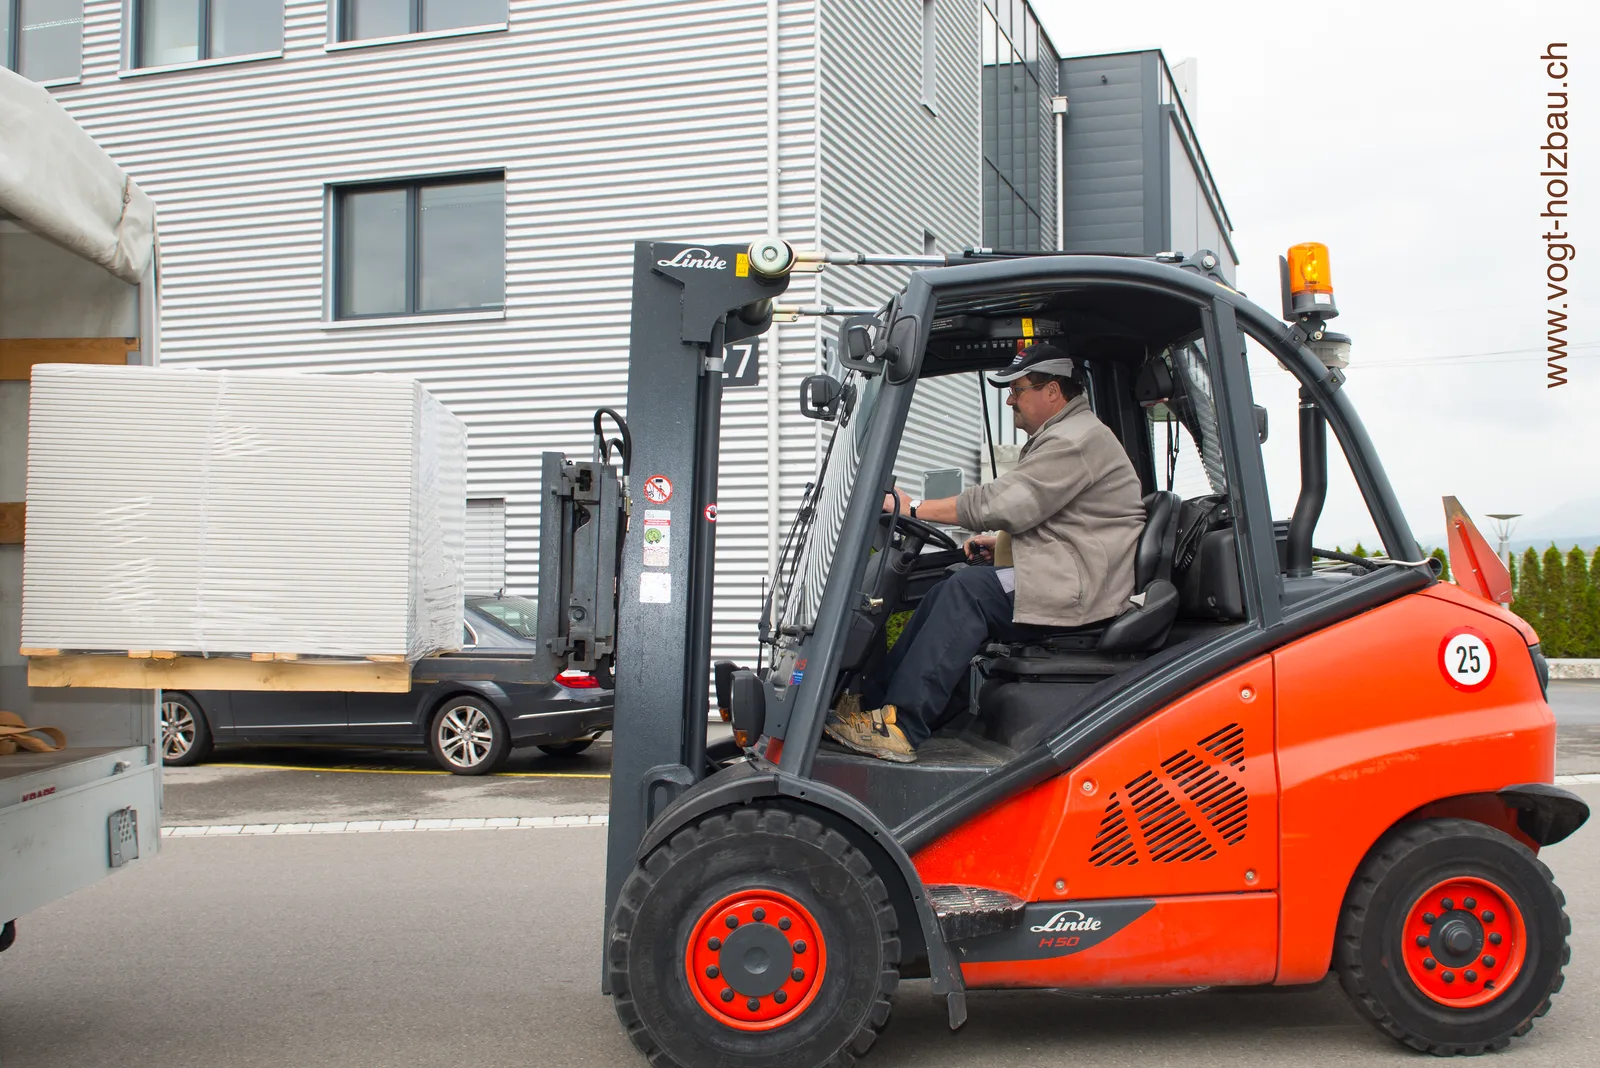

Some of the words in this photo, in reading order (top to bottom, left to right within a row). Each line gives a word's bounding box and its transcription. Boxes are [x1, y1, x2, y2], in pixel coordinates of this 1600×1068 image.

[657, 247, 727, 270] Linde
[722, 343, 753, 379] 7
[1456, 645, 1481, 674] 25
[1030, 910, 1102, 933] Linde
